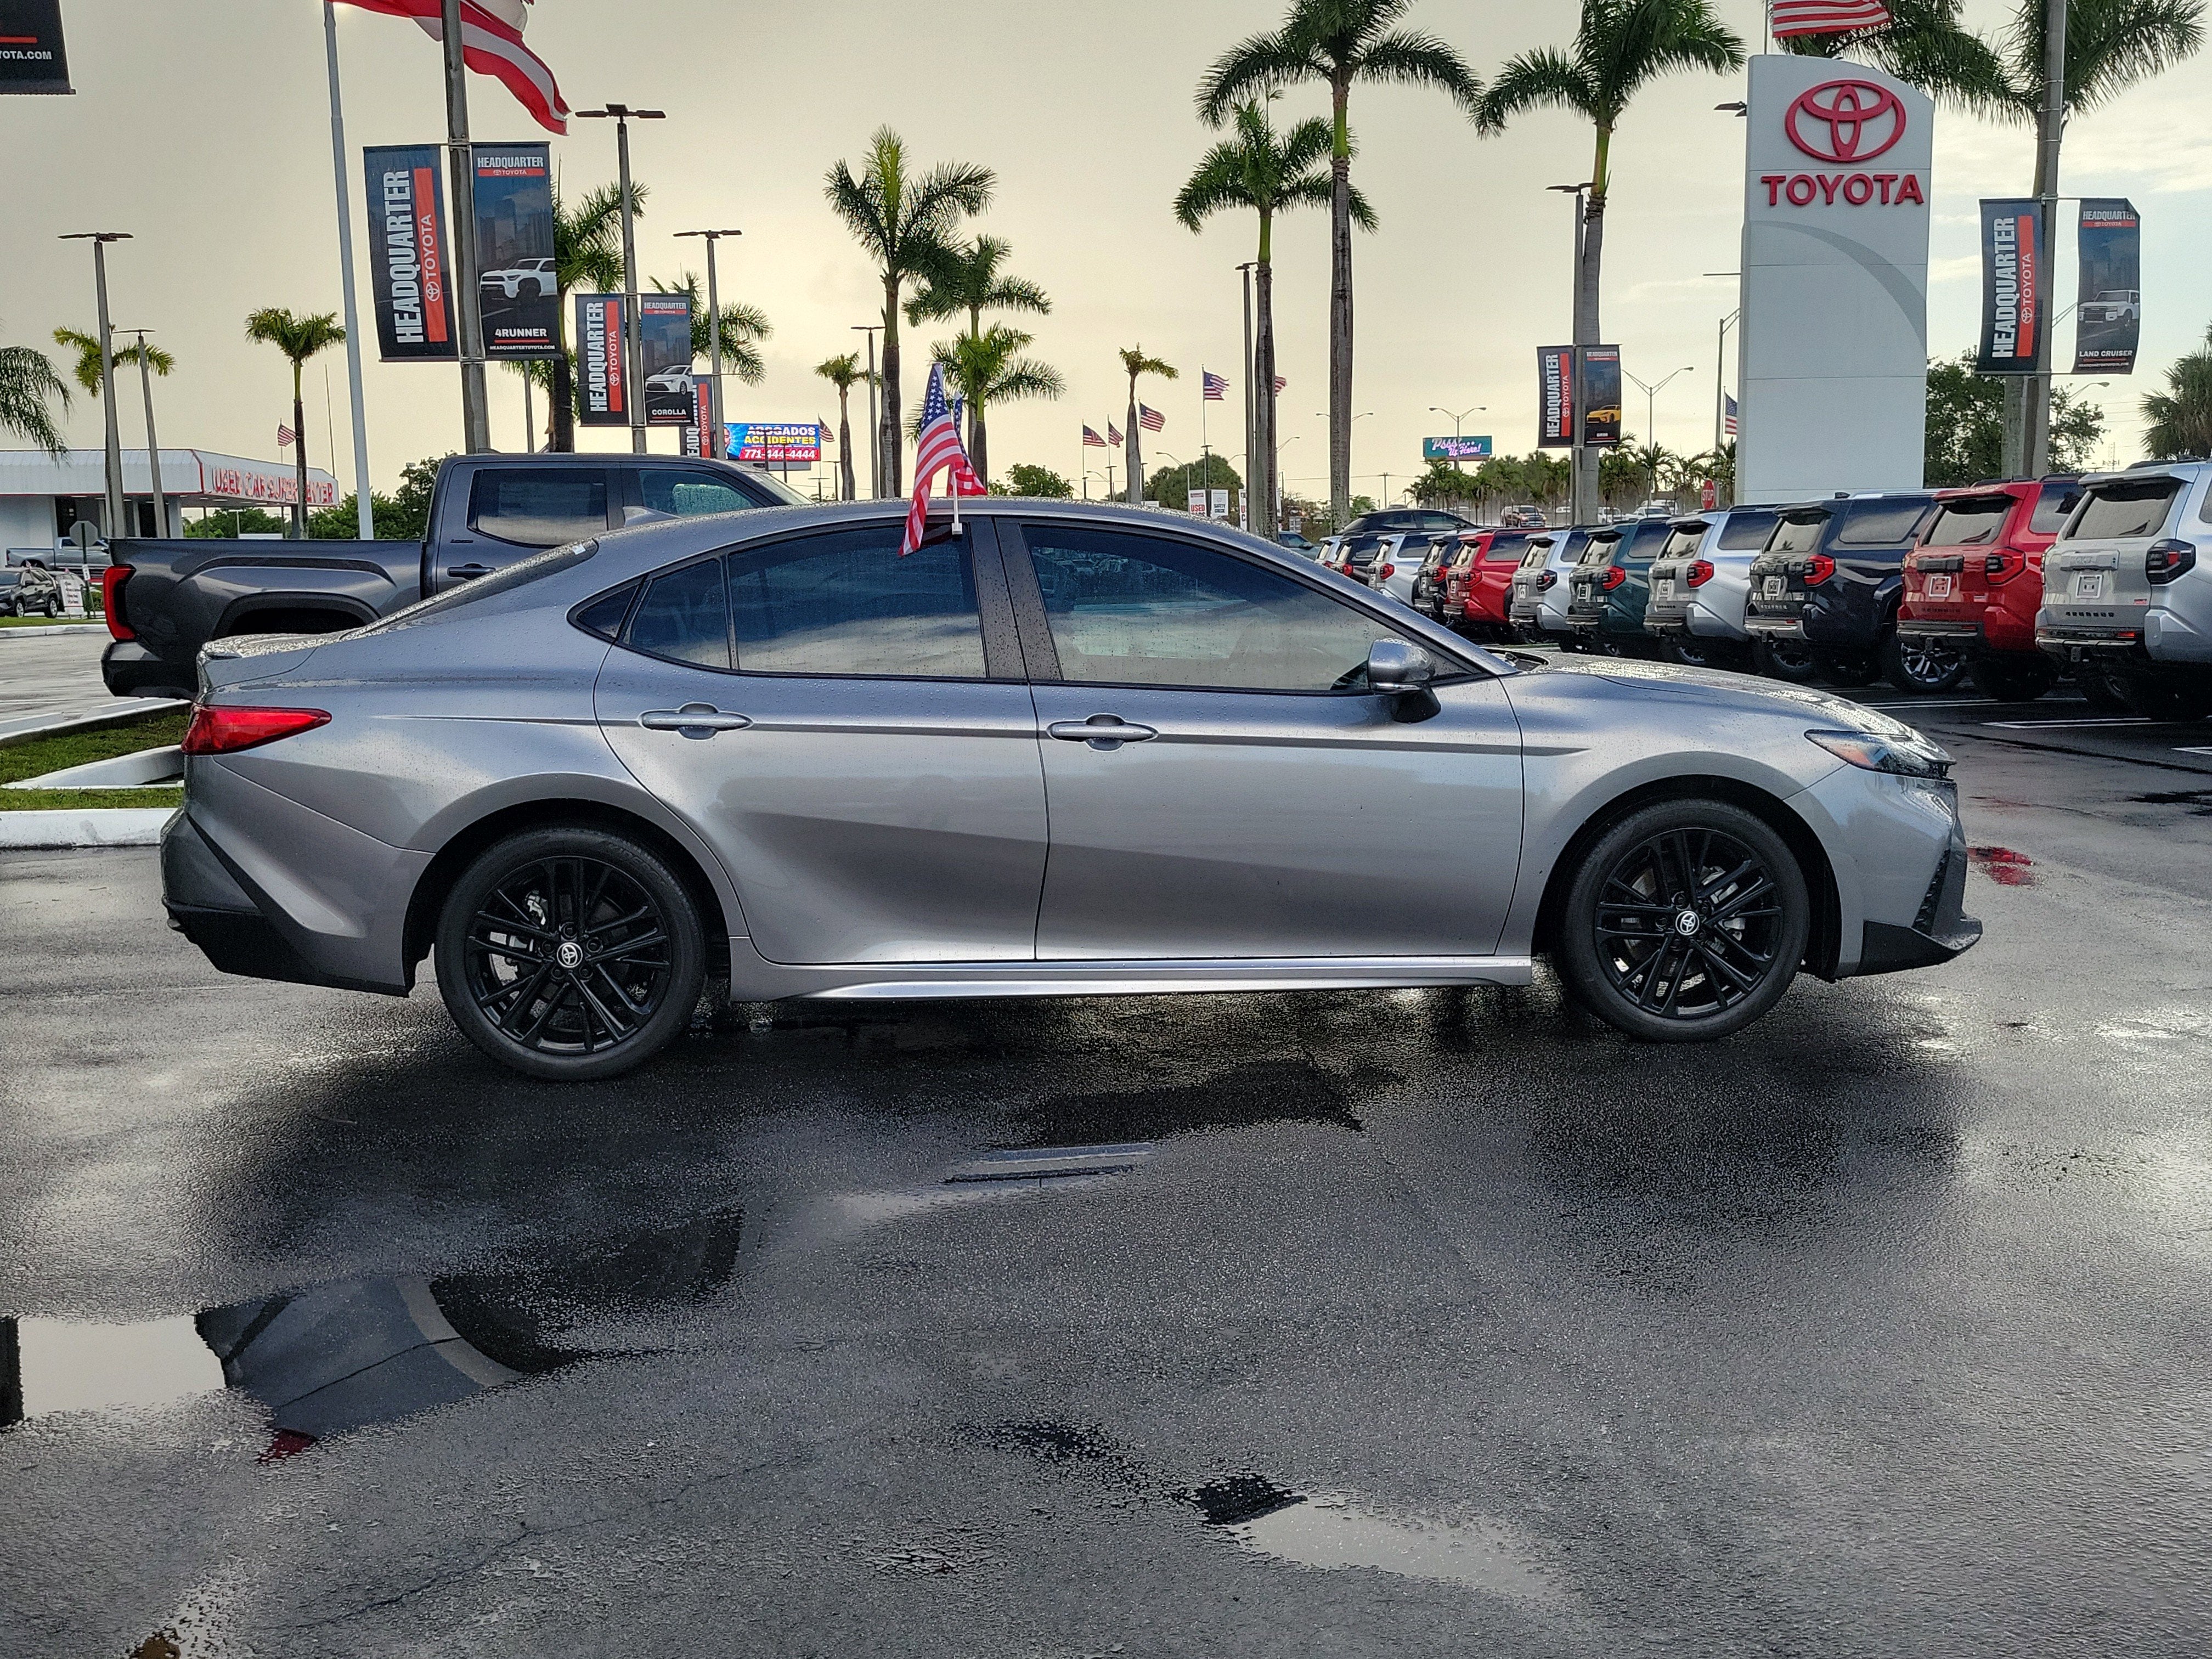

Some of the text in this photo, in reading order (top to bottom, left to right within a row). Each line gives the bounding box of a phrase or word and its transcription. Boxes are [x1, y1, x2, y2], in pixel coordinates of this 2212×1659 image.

[477, 156, 544, 169] HEADQUARTER
[1760, 173, 1924, 206] TOYOTA
[2083, 211, 2136, 221] HEADQUARTER
[383, 170, 424, 343] HEADQUARTER
[421, 213, 437, 279] TOYOTA
[1992, 217, 2020, 358] HEADQUARTER
[2022, 253, 2032, 306] TOYOTA
[644, 302, 686, 310] HEADQUARTER
[495, 328, 547, 337] 4RUNNER
[586, 302, 608, 411] HEADQUARTER
[609, 331, 617, 372] TOYOTA
[1545, 354, 1561, 437] HEADQUARTER
[744, 436, 816, 444] ACCIDENTES
[211, 466, 241, 494] USED
[245, 472, 265, 498] CAR
[305, 481, 334, 503] ENTER
[1702, 489, 1713, 501] STOP
